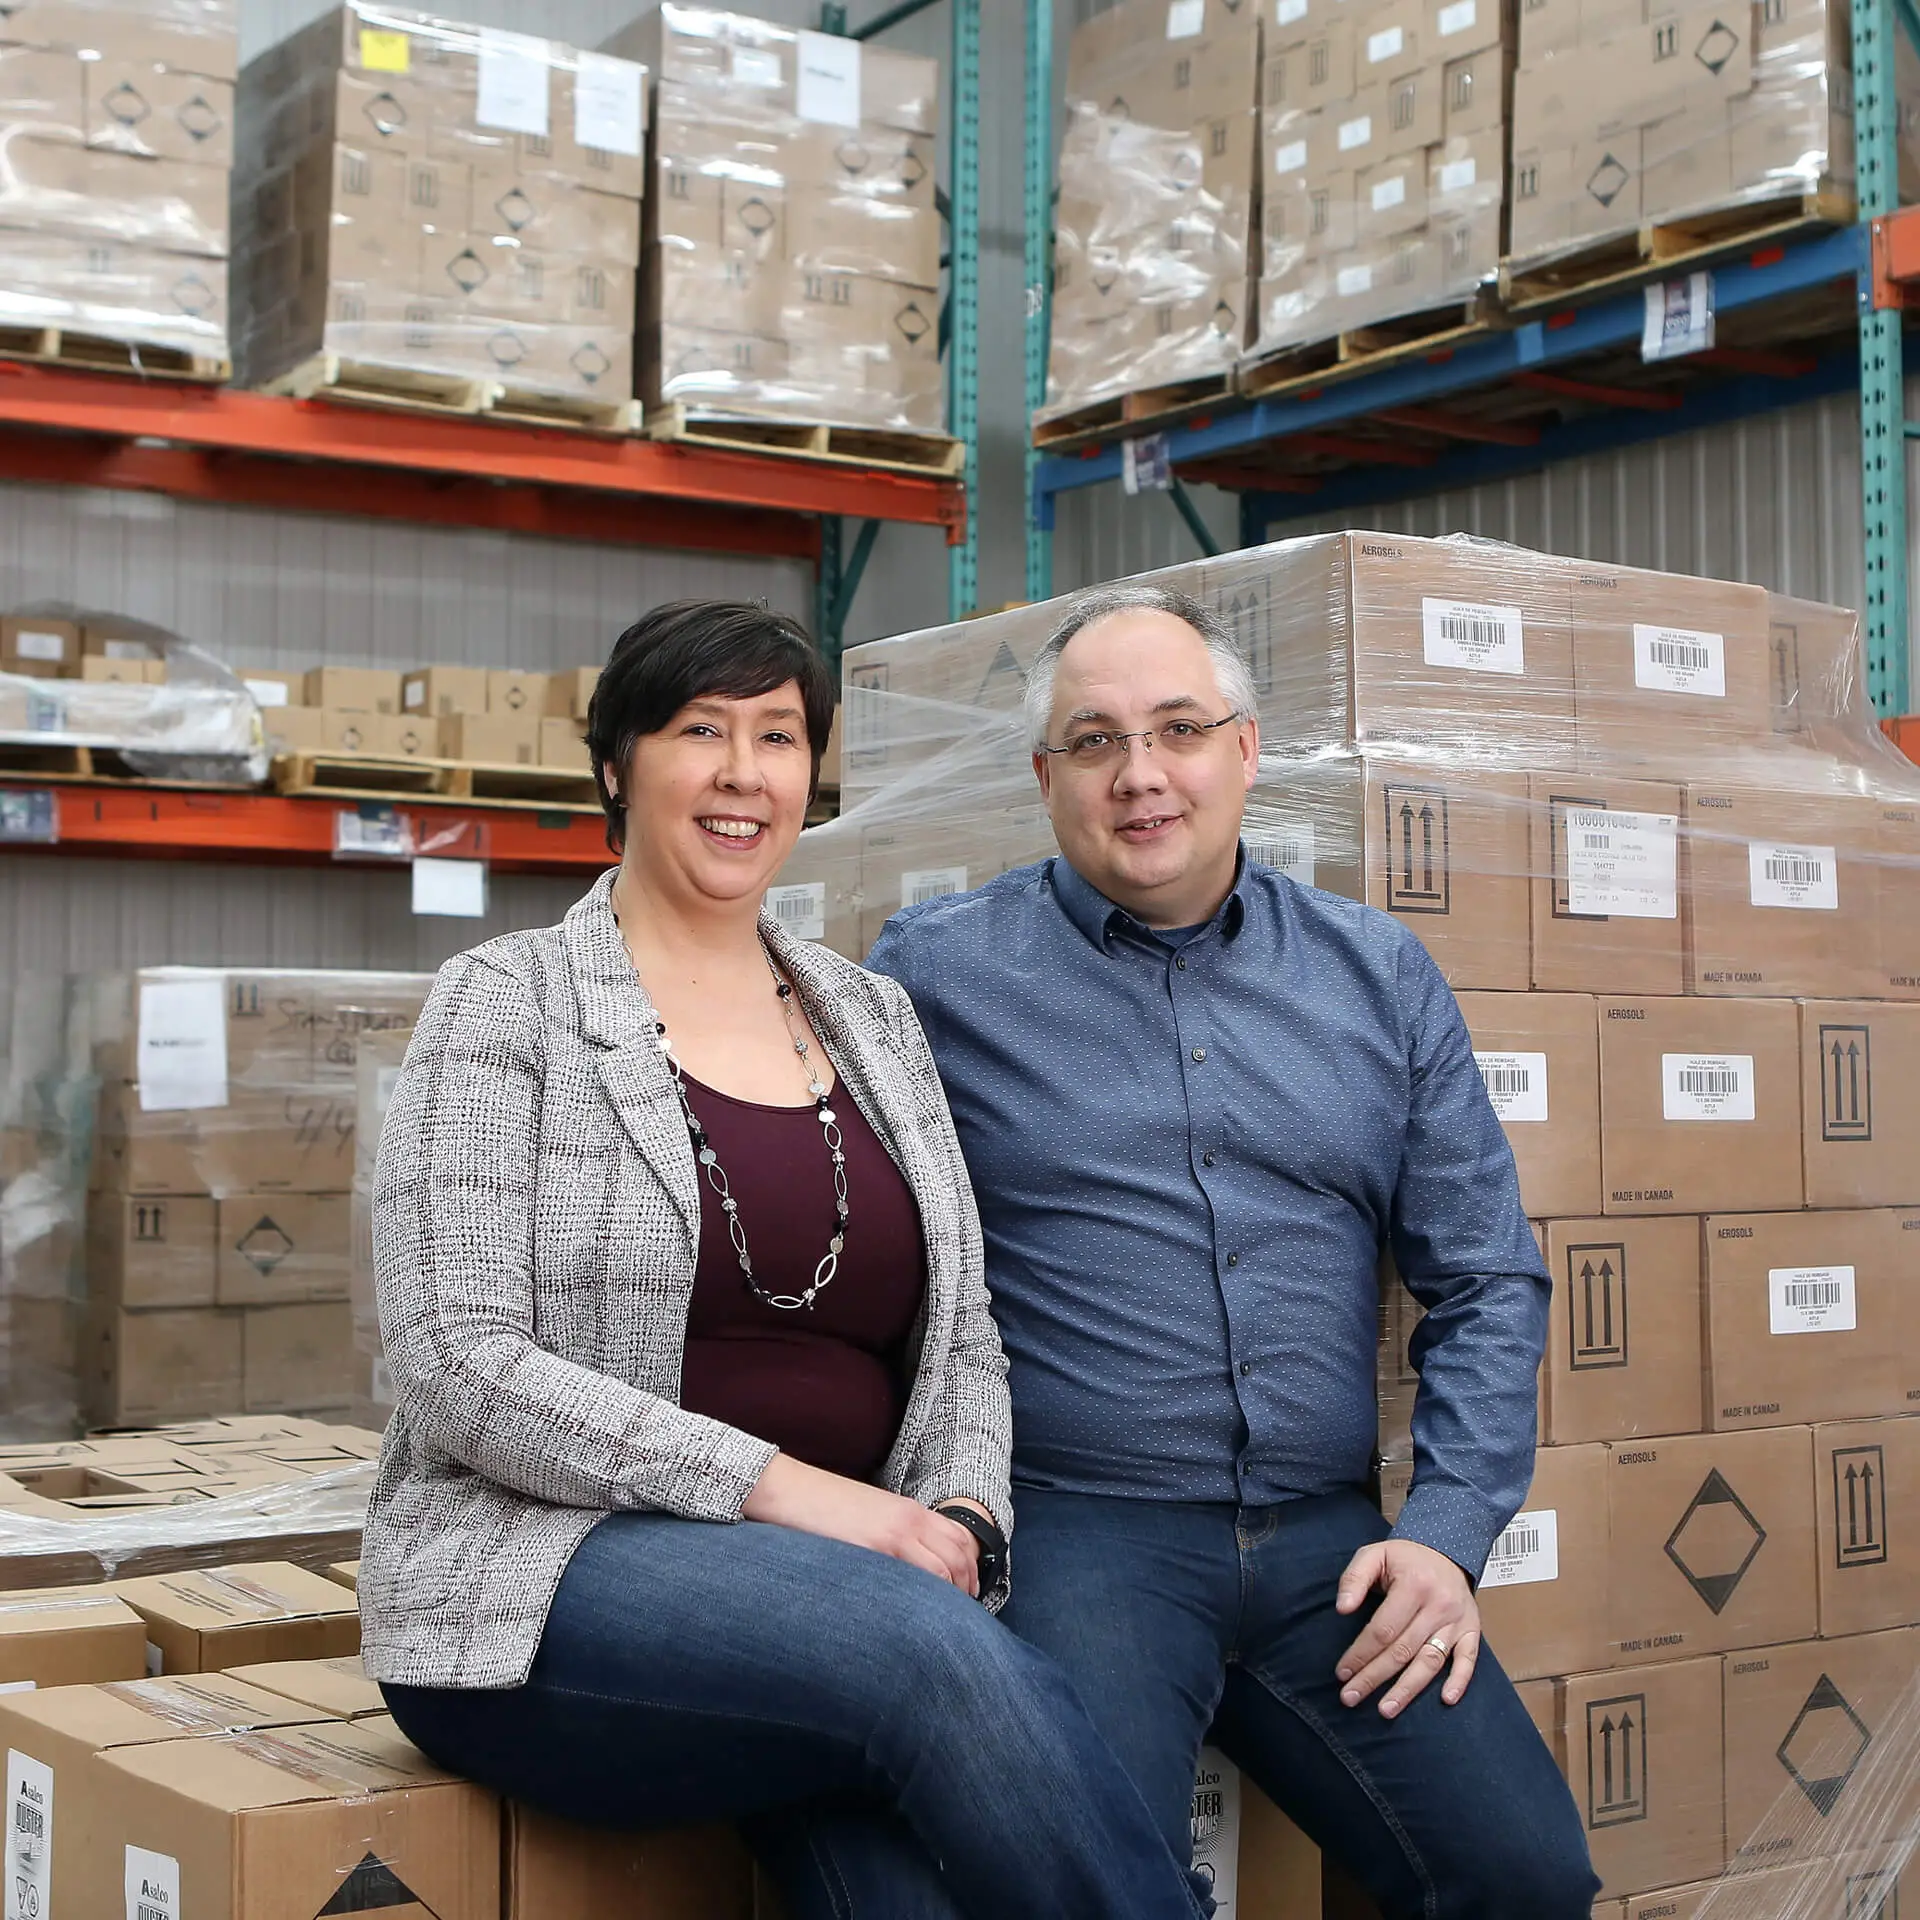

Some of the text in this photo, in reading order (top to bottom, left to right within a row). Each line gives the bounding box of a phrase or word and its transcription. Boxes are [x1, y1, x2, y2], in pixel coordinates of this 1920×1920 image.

[1361, 544, 1403, 559] AEROSOLS
[1580, 575, 1618, 589] AEROSOLS
[1697, 797, 1733, 809] AEROSOLS
[1704, 972, 1763, 983] MADE IN CANADA
[1890, 977, 1908, 987] MADE
[1909, 977, 1916, 987] IN
[1607, 1008, 1645, 1021] AEROSOLS
[1612, 1190, 1674, 1202] MADE IN CANADA
[1902, 1220, 1920, 1231] AERO
[1717, 1227, 1754, 1240] AEROSOLS
[1906, 1390, 1920, 1401] MAD
[1723, 1403, 1780, 1418] MADE IN CANADA
[1617, 1451, 1657, 1465] AEROSOLS
[1620, 1634, 1684, 1653] MADE IN CANADA
[1733, 1660, 1770, 1675] AEROSOLS
[1195, 1769, 1220, 1786] alco
[1191, 1792, 1222, 1818] STER
[16, 1802, 44, 1839] DUSTER
[1638, 1904, 1677, 1920] AEROSOLS
